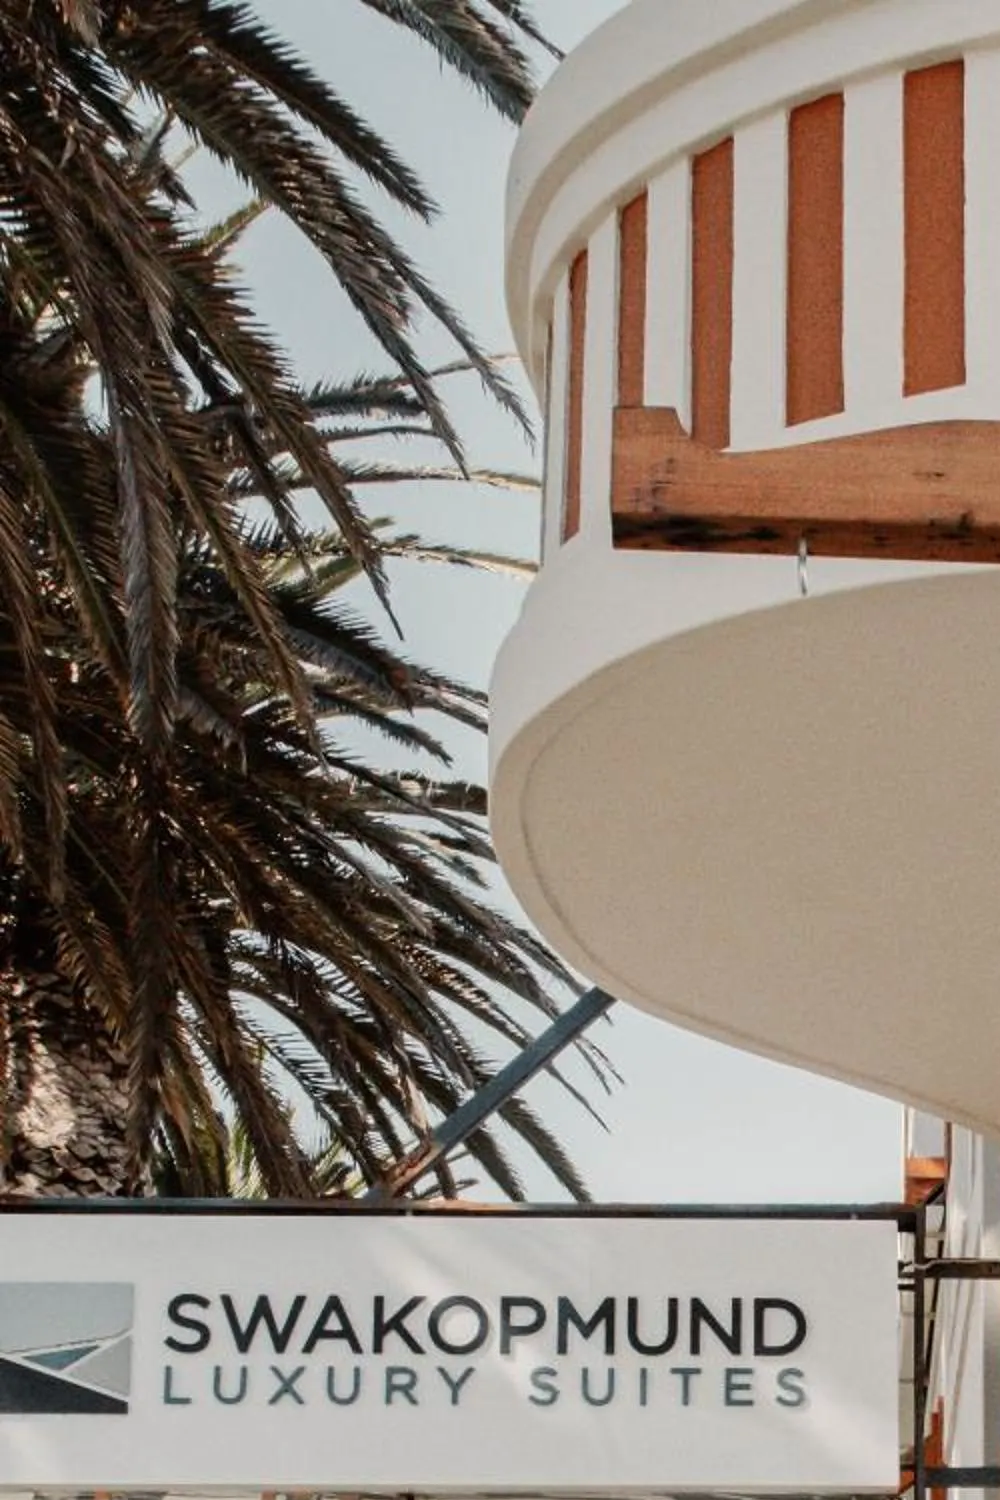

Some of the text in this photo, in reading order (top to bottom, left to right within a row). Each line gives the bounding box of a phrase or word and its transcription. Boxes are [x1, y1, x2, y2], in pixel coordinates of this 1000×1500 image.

[163, 1292, 808, 1357] SWAKOPMUND
[163, 1365, 809, 1408] LUXURY SUITES
